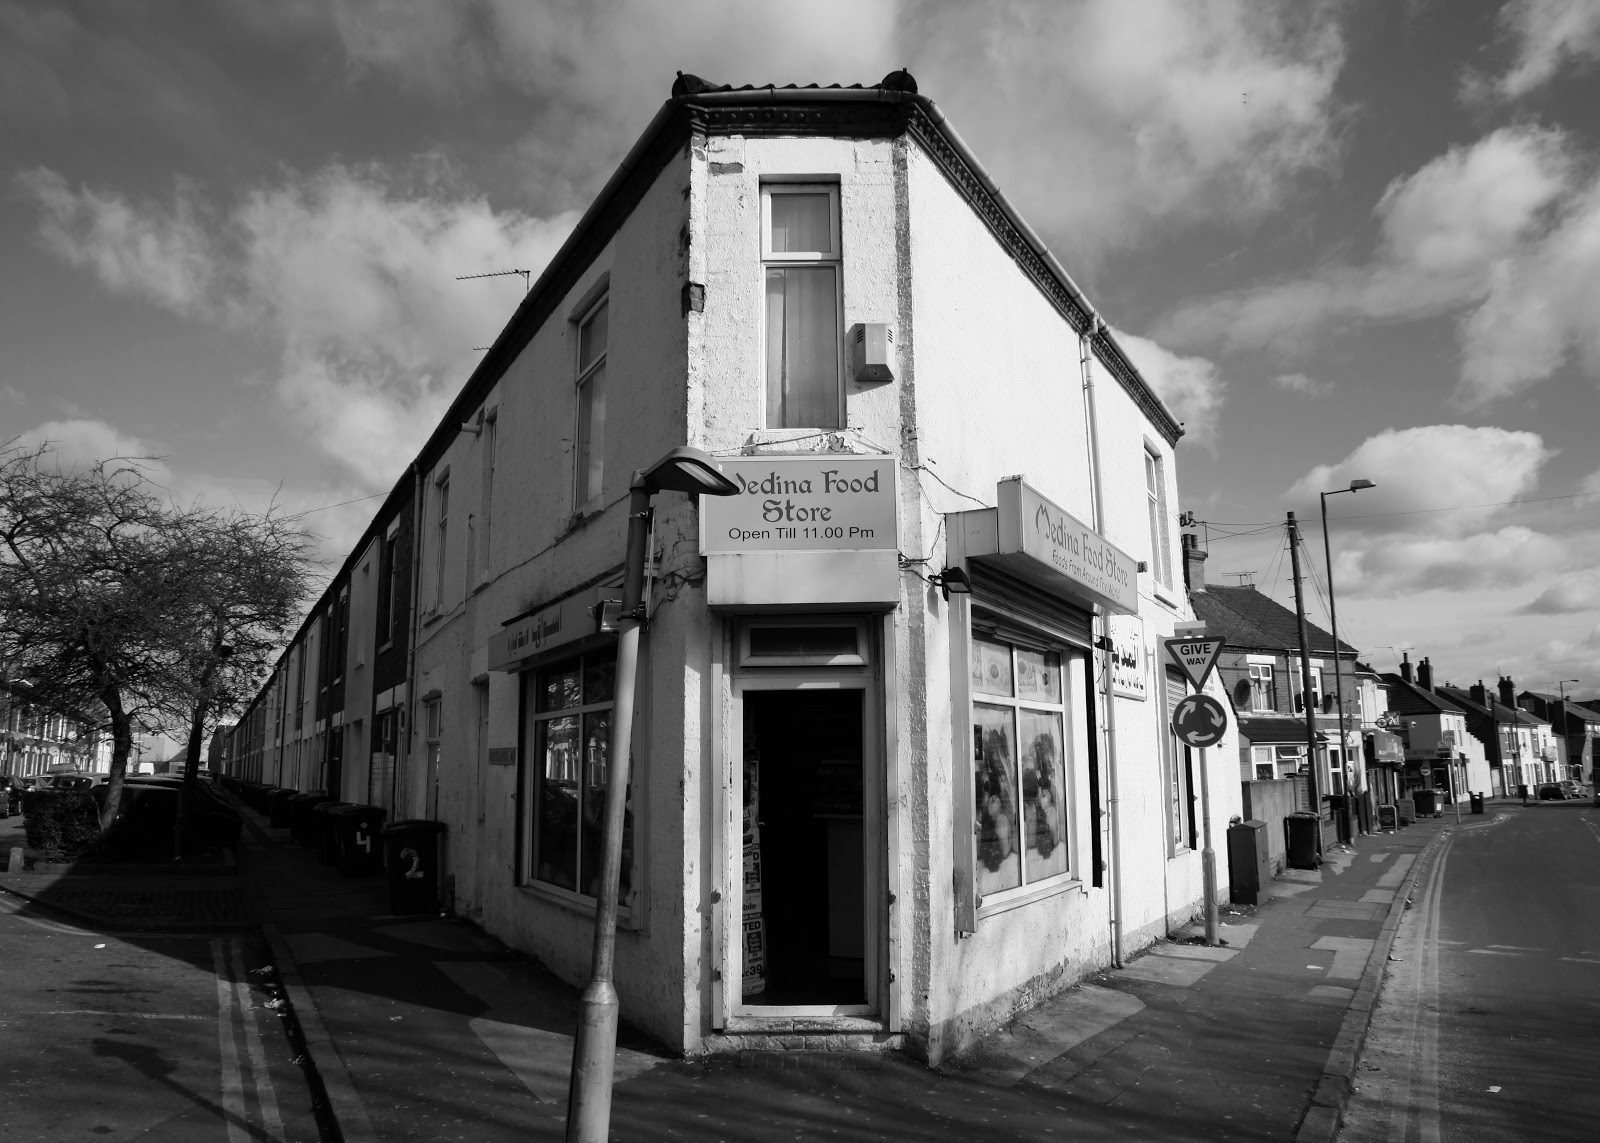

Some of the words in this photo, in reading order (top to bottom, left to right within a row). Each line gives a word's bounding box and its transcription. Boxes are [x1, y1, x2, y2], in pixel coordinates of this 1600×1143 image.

[821, 469, 880, 494] Food
[762, 499, 832, 523] Store
[728, 527, 770, 541] Open
[775, 527, 796, 539] Till
[803, 527, 844, 539] 11.00
[849, 526, 875, 539] Pm
[1035, 502, 1080, 556] Medina
[1082, 531, 1104, 572] Food
[1105, 548, 1128, 588] Store
[1052, 549, 1068, 570] Foods
[1069, 559, 1082, 579] From
[1082, 567, 1099, 588] Around
[1180, 643, 1212, 656] GIVE
[1186, 656, 1207, 666] WAY
[356, 831, 371, 853] 4
[400, 848, 424, 879] 2
[742, 921, 761, 931] TED
